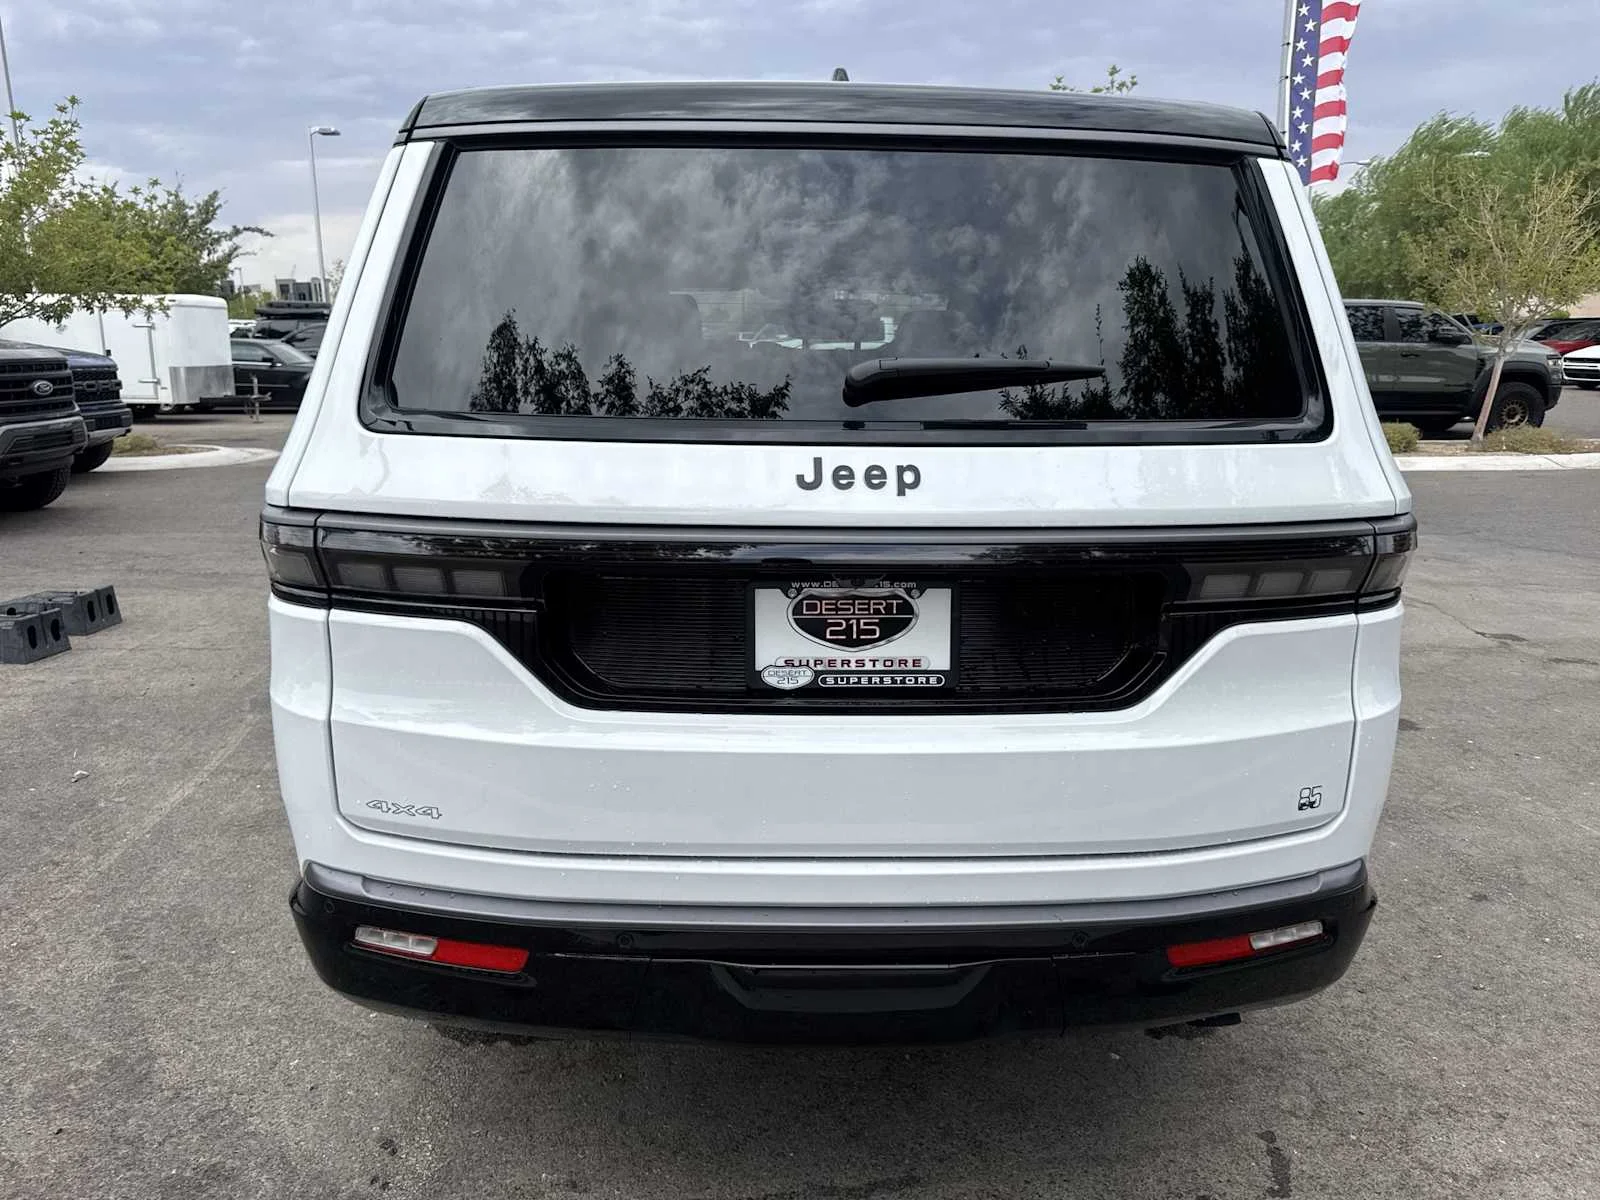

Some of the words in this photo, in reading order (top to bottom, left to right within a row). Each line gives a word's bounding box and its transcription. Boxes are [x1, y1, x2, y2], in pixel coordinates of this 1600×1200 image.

[796, 456, 921, 497] Jeep
[803, 600, 903, 614] DESERT
[826, 619, 880, 639] 215
[784, 659, 922, 668] SUPERSTORE
[777, 677, 799, 685] 215
[826, 676, 939, 685] SUPERSTORE
